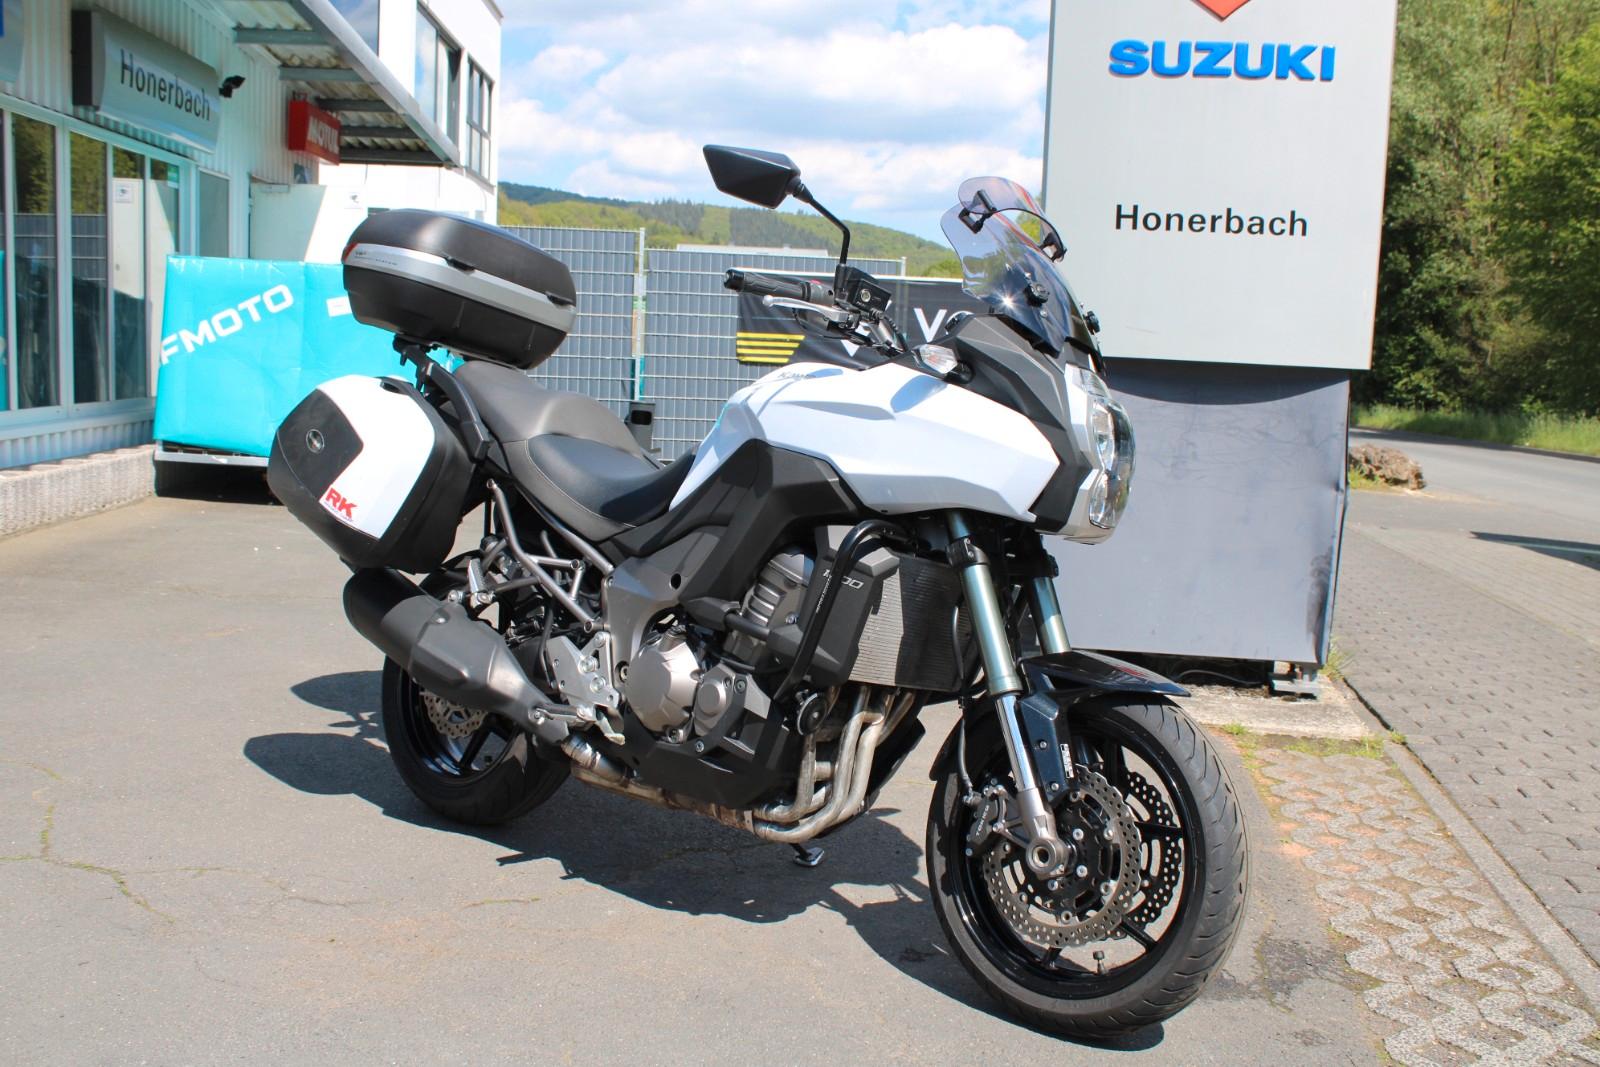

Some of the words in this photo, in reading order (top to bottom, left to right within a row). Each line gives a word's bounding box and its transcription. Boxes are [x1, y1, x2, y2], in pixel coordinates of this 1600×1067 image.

[1108, 39, 1336, 82] SUZUKI
[121, 48, 210, 121] Honerbach
[307, 115, 340, 155] MOTUL
[1115, 203, 1308, 237] Honerbach
[325, 487, 358, 520] RK
